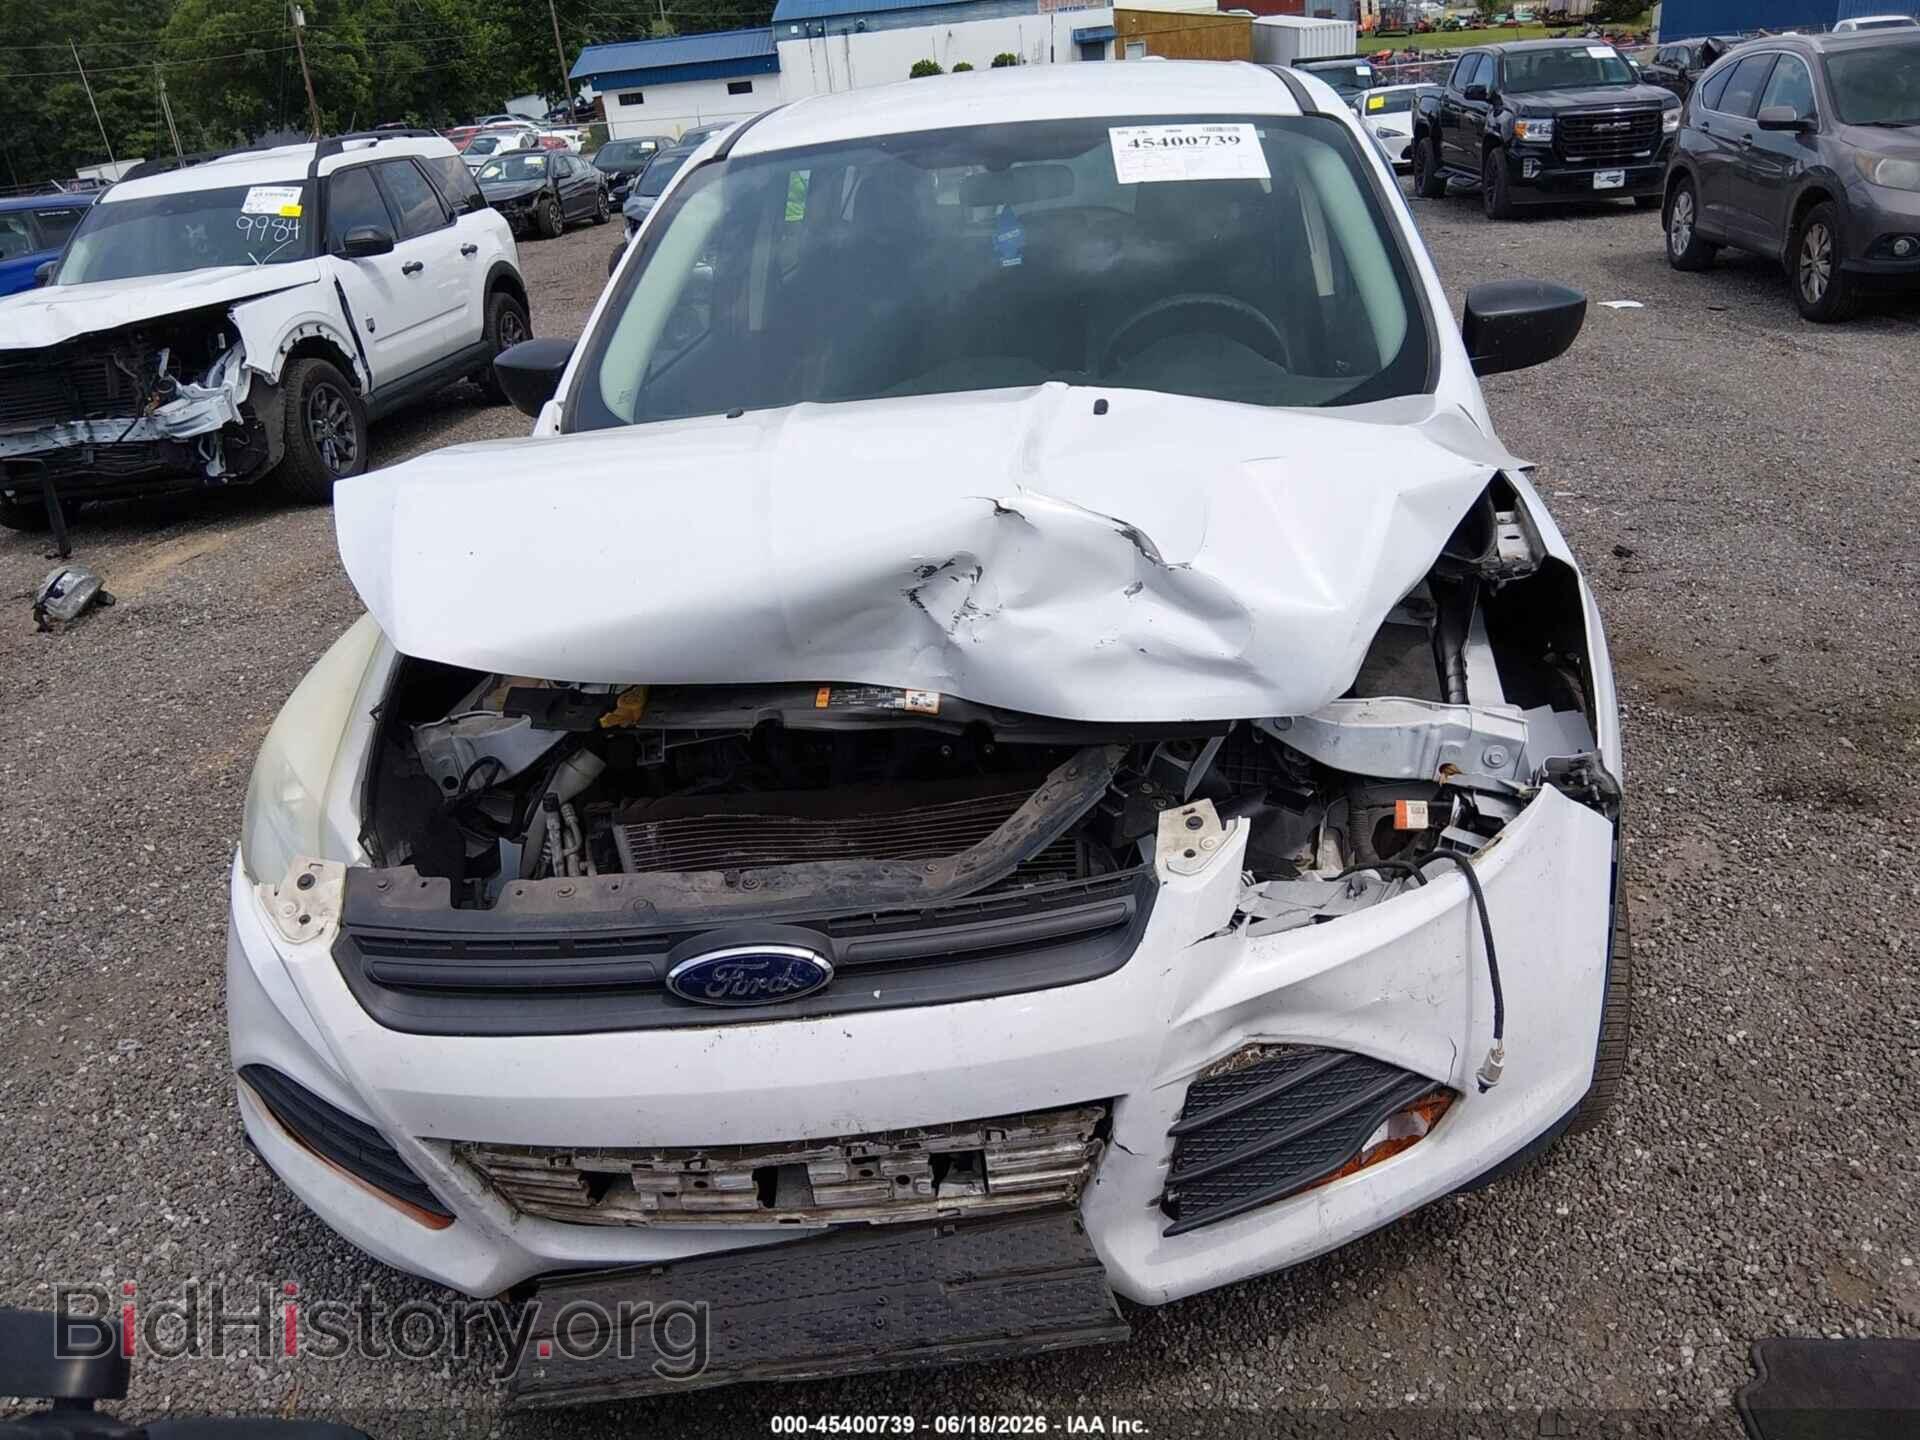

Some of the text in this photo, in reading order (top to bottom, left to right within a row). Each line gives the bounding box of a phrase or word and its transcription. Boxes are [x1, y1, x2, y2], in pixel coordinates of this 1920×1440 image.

[1128, 135, 1241, 149] 45400739
[236, 215, 301, 242] 9984
[704, 961, 805, 997] Ford
